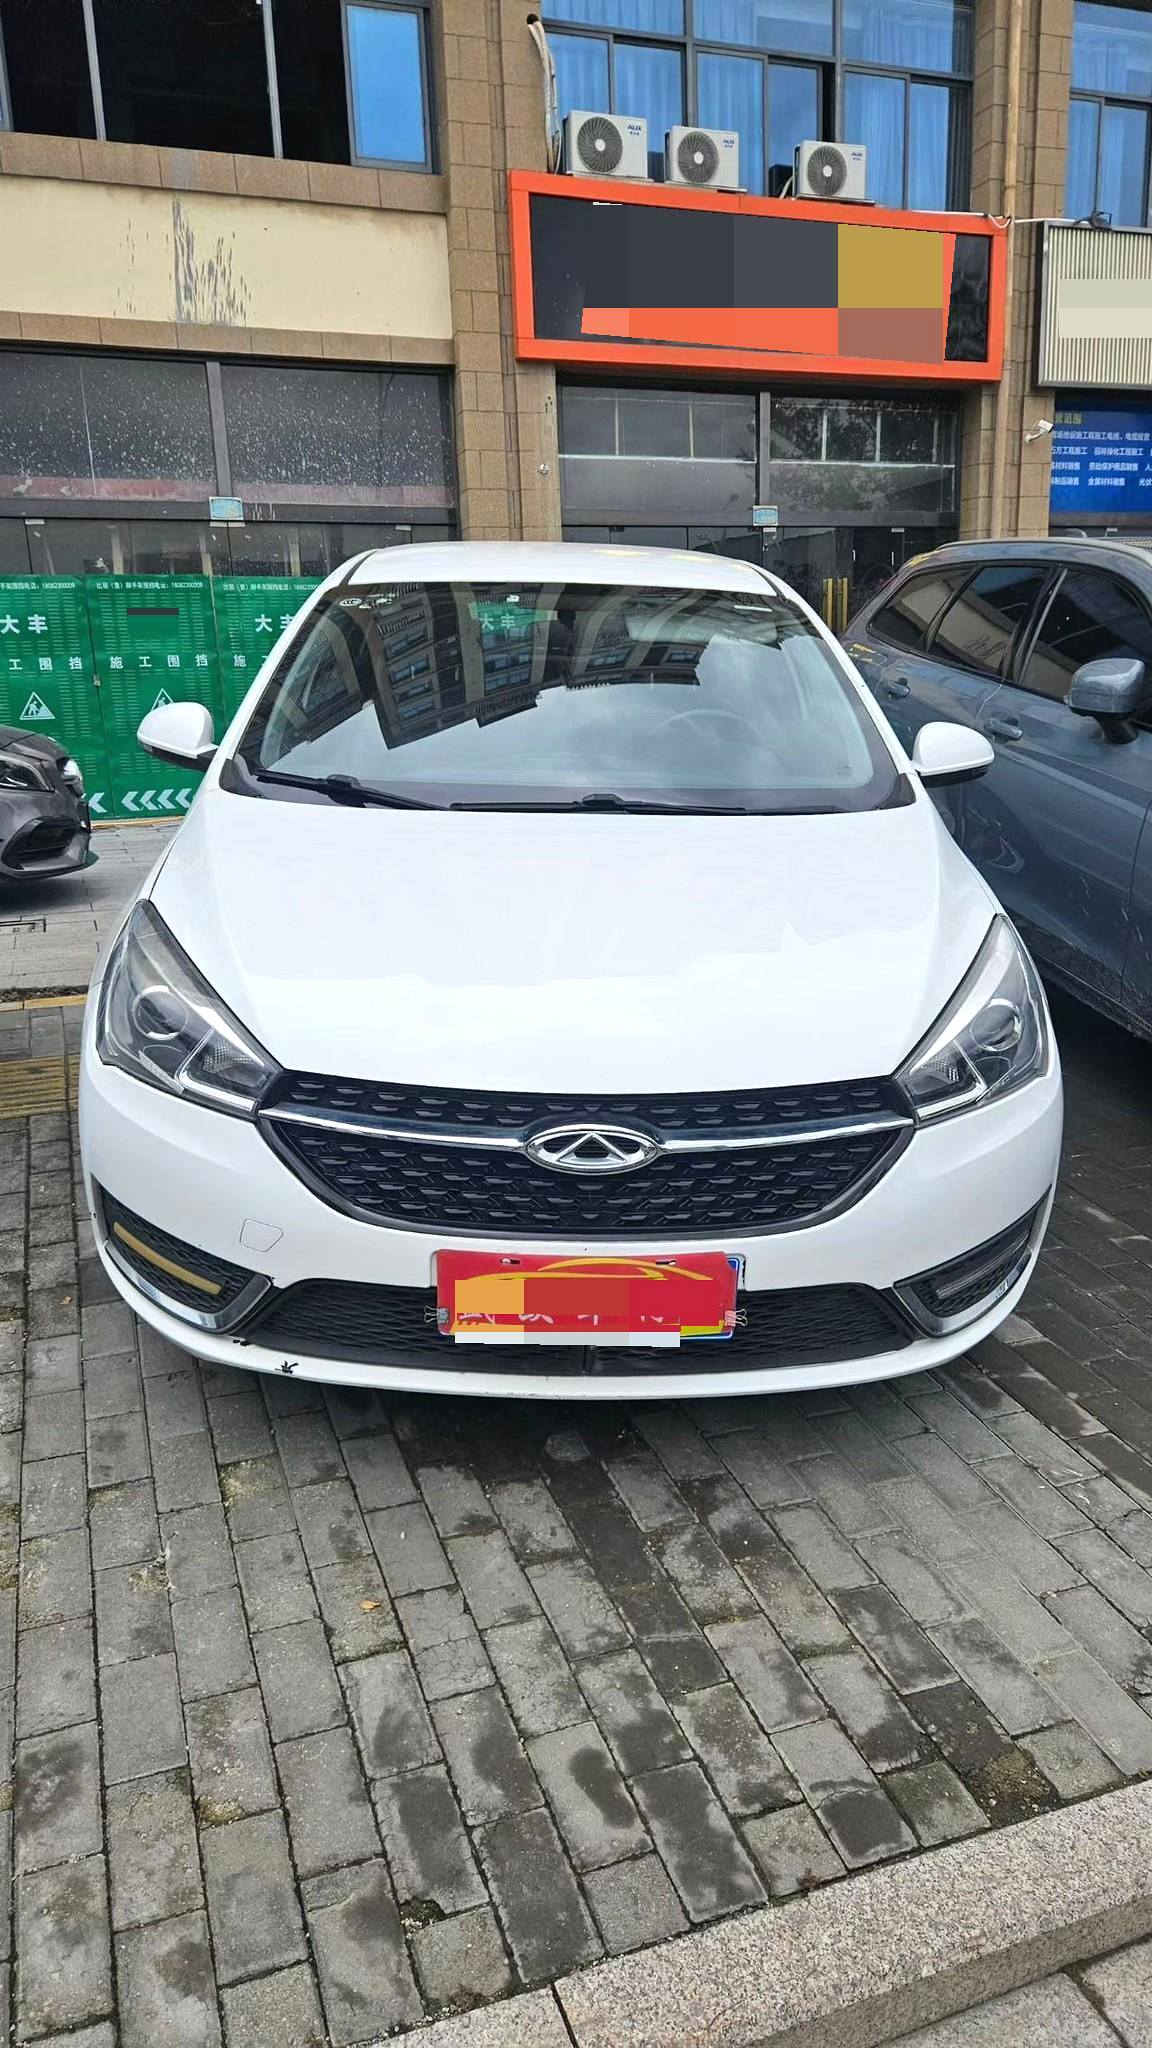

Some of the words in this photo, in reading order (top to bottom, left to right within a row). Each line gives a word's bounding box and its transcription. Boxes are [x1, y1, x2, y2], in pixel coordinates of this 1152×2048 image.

[0, 614, 48, 634] 大丰
[480, 613, 516, 630] 大丰
[109, 654, 208, 669] 施工围挡
